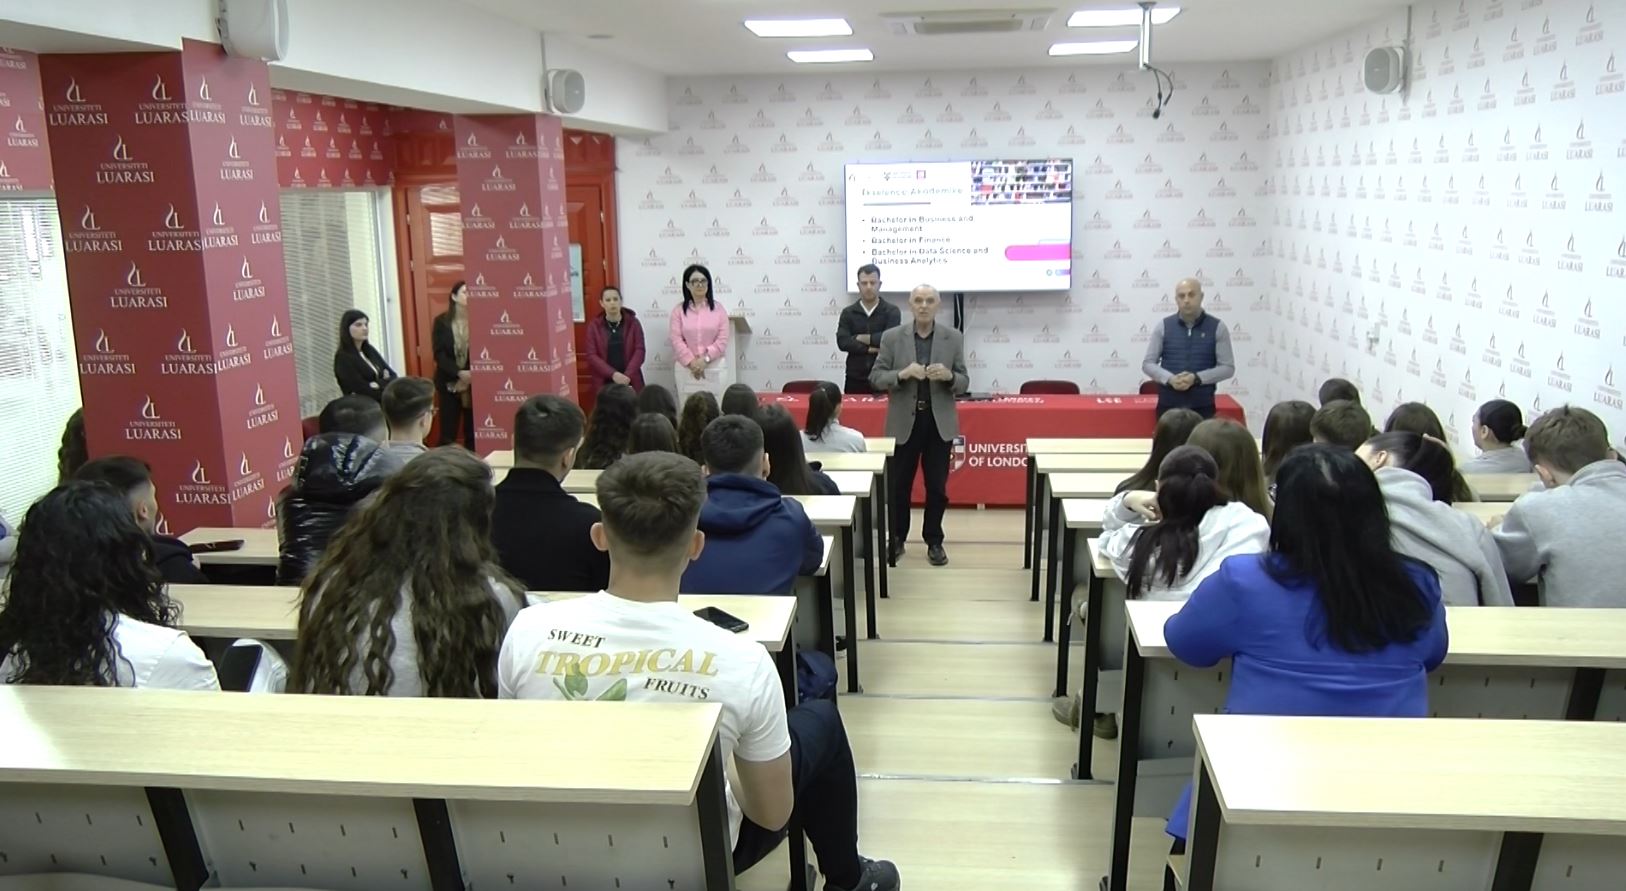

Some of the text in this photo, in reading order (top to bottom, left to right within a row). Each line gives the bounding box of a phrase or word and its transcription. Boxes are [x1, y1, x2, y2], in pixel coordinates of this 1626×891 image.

[49, 112, 108, 126] LUARASI
[96, 171, 155, 183] LUARASI
[220, 168, 254, 180] LUARASI
[204, 234, 239, 249] LUARASI
[251, 231, 282, 244] LUARASI
[65, 240, 123, 252] LUARASI
[148, 238, 204, 251] LUARASI
[233, 286, 266, 301] LUARASI
[110, 296, 168, 308] LUARASI
[263, 342, 293, 359] LUARASI
[80, 363, 136, 374] LUARASI
[217, 353, 251, 371] LUARASI
[161, 363, 217, 375] LUARASI
[246, 410, 279, 429] LUARASI
[125, 428, 182, 440] LUARASI
[968, 457, 1029, 467] OF LONDO
[232, 478, 265, 501] LUARASI
[175, 493, 231, 504] LUARASI
[547, 628, 606, 649] SWEET
[534, 648, 719, 678] TROPICAL
[643, 677, 710, 701] FRUITS
